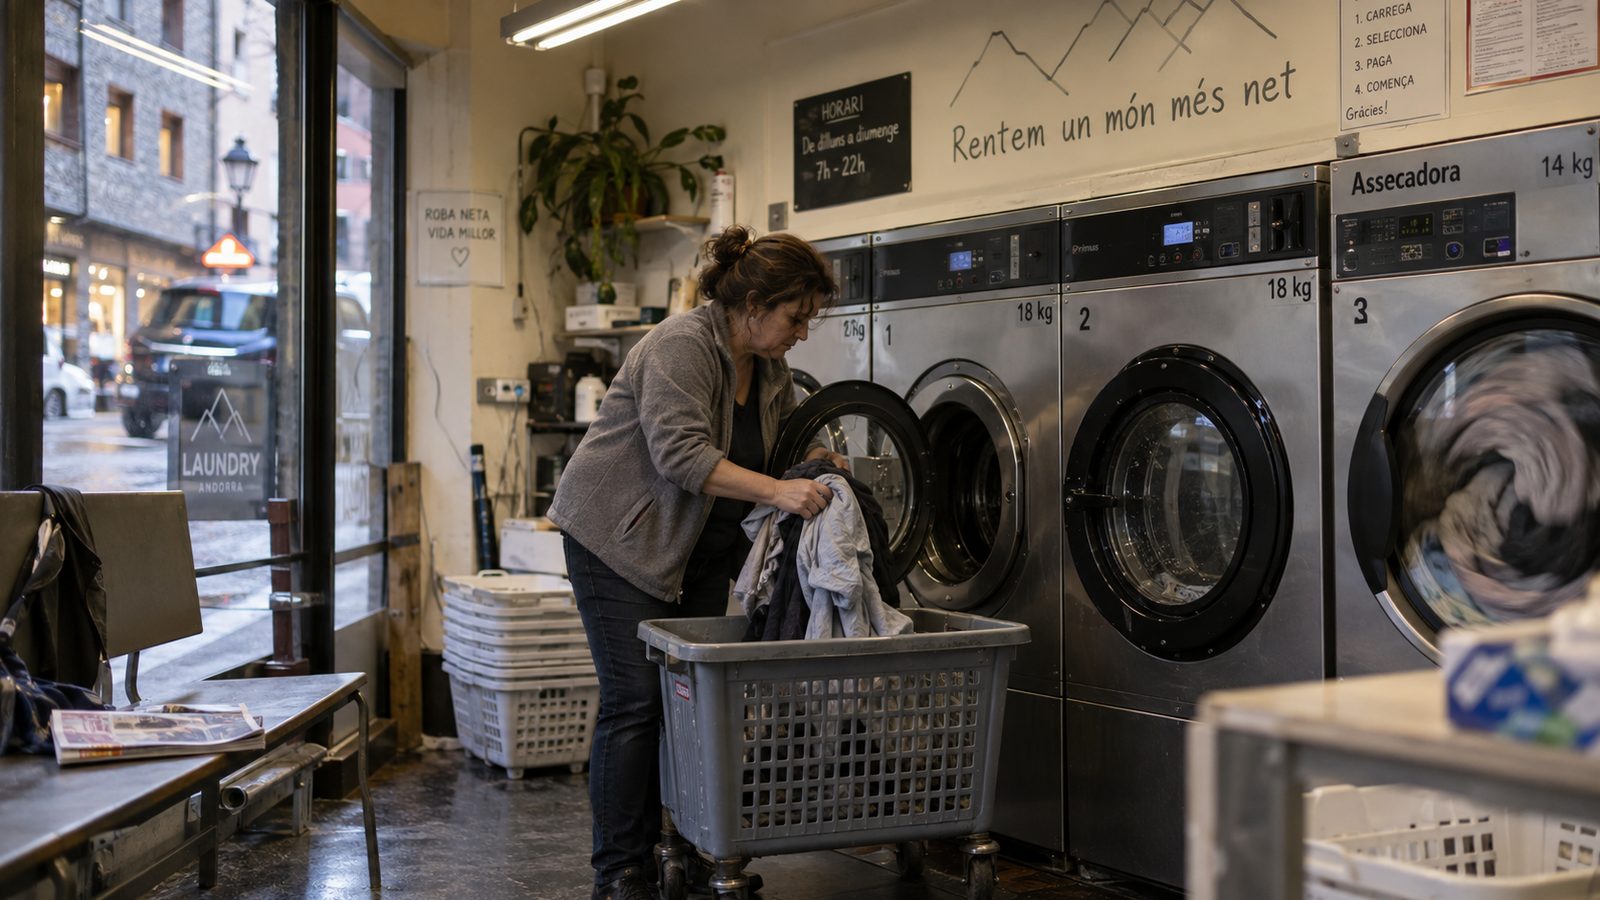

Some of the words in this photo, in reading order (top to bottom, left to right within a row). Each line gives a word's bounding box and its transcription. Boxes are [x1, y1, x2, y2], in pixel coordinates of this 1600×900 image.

[1355, 14, 1363, 24] 1.
[1366, 2, 1412, 22] CARREGA
[1355, 36, 1363, 48] 2.
[1366, 23, 1427, 46] SELECCIONA
[1355, 60, 1363, 72] 3.
[1366, 54, 1392, 69] PAGA
[1355, 84, 1363, 95] 4.
[1366, 74, 1414, 93] COMENÇA
[822, 94, 864, 121] HORARI
[952, 121, 1045, 163] Rentem
[1062, 115, 1091, 142] un
[1105, 92, 1155, 134] món
[1171, 77, 1225, 122] més
[1244, 60, 1297, 106] net
[802, 135, 816, 155] De
[817, 132, 845, 151] dilluns
[847, 133, 854, 145] a
[855, 122, 899, 143] diumenge
[816, 160, 831, 182] 7h
[841, 153, 865, 177] 22h
[1541, 154, 1564, 178] 14
[1572, 151, 1594, 179] kg
[1351, 161, 1461, 196] Assecadora
[425, 207, 456, 221] ROBA
[460, 208, 490, 222] NETA
[428, 227, 455, 239] VIDA
[458, 227, 496, 241] MILLOR
[1268, 278, 1288, 299] 18
[1292, 275, 1312, 302] kg
[1017, 302, 1033, 322] 18
[1037, 302, 1053, 325] kg
[1079, 307, 1091, 331] 2
[1353, 297, 1368, 325] 3
[885, 324, 891, 346] 1
[182, 452, 261, 477] LAUNDRY
[199, 481, 244, 494] ANDORRA
